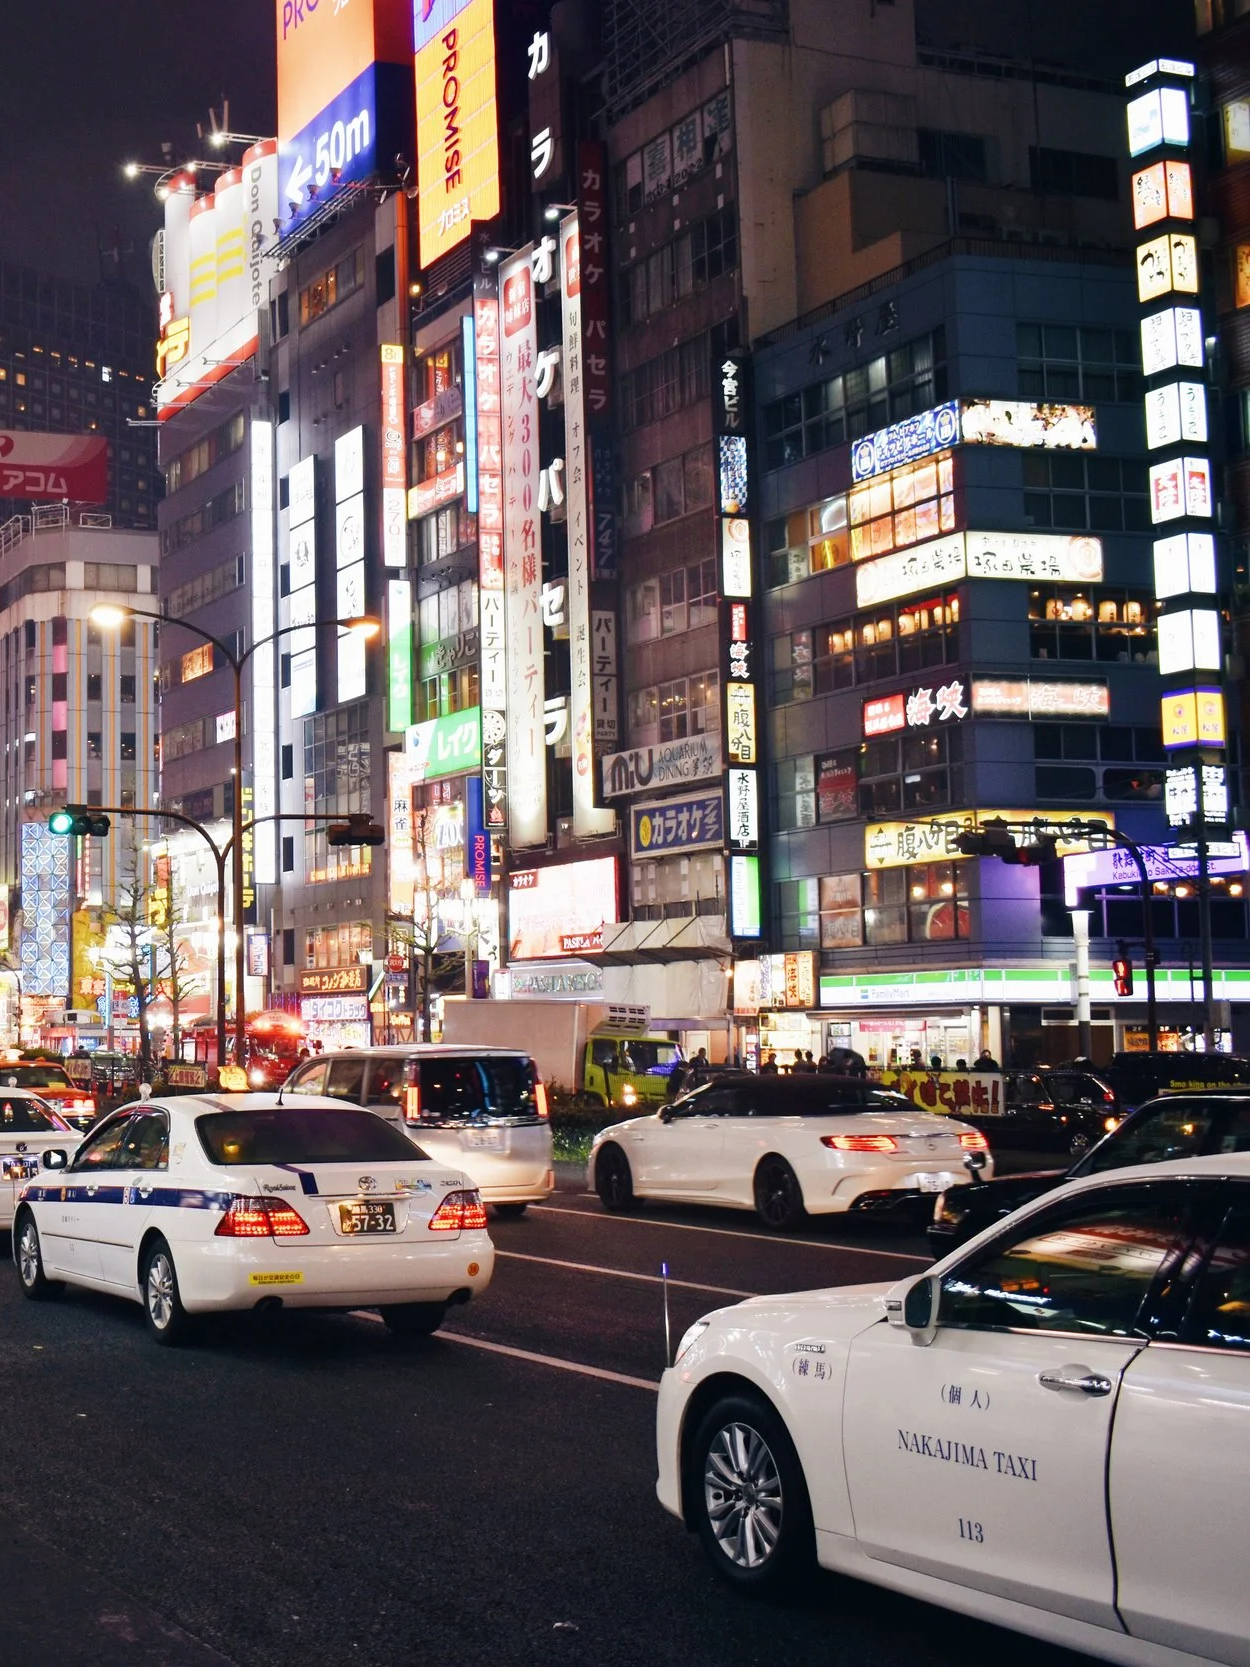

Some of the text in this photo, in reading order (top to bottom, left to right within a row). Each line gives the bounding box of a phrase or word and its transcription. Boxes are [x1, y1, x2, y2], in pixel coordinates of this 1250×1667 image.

[442, 28, 461, 194] PROMISE
[315, 109, 370, 188] 50m
[251, 165, 264, 215] Don
[436, 197, 471, 237] プロミス
[478, 306, 498, 411] カラオケ
[528, 31, 568, 745] カラオケ パセラ
[721, 360, 739, 428] 今宮ビル
[2, 470, 68, 494] アコム
[480, 443, 500, 524] パセラ
[484, 597, 500, 685] パーティー
[595, 617, 612, 713] パーティー
[437, 720, 477, 761] レイク
[658, 740, 708, 763] AQUARIUM
[658, 760, 689, 782] DINING
[393, 800, 409, 831] 麻雀
[652, 804, 703, 845] カラオケ
[736, 773, 751, 838] 水野屋酒店
[474, 835, 486, 887] PROMISE
[871, 988, 910, 999] FamilyMart
[353, 1215, 394, 1231] 57-32
[368, 1204, 383, 1214] 330
[897, 1429, 1038, 1482] NAKAJIMA TAXI
[958, 1518, 984, 1543] 113
